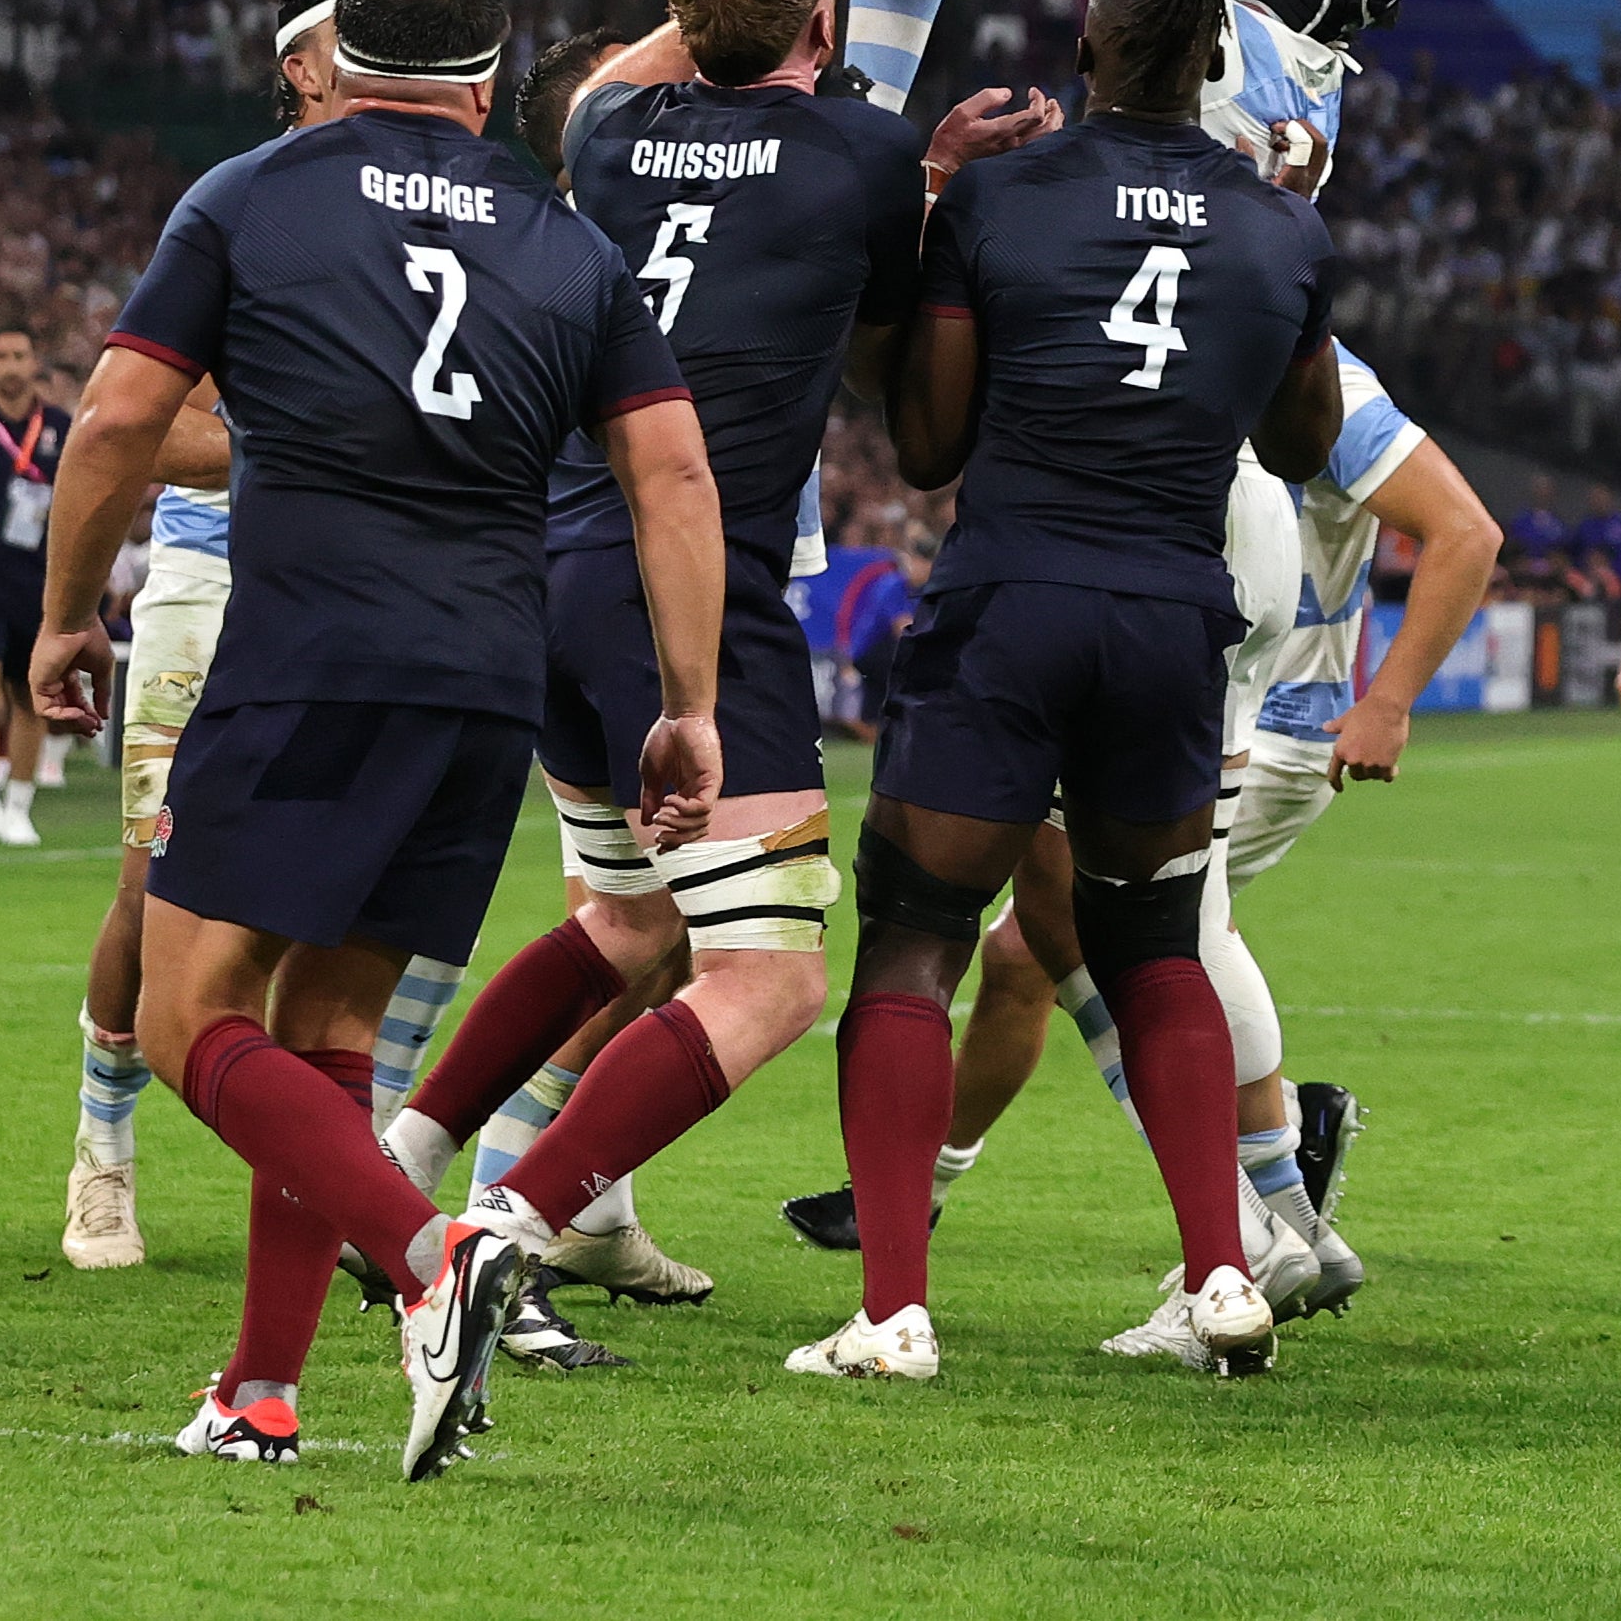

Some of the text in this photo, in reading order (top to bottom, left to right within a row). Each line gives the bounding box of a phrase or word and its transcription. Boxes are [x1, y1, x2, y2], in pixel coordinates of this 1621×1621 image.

[360, 165, 496, 224] GEORGE
[1115, 185, 1208, 227] ITOJE
[403, 241, 483, 421] 2
[636, 202, 715, 336] 5
[1099, 245, 1192, 390] 4
